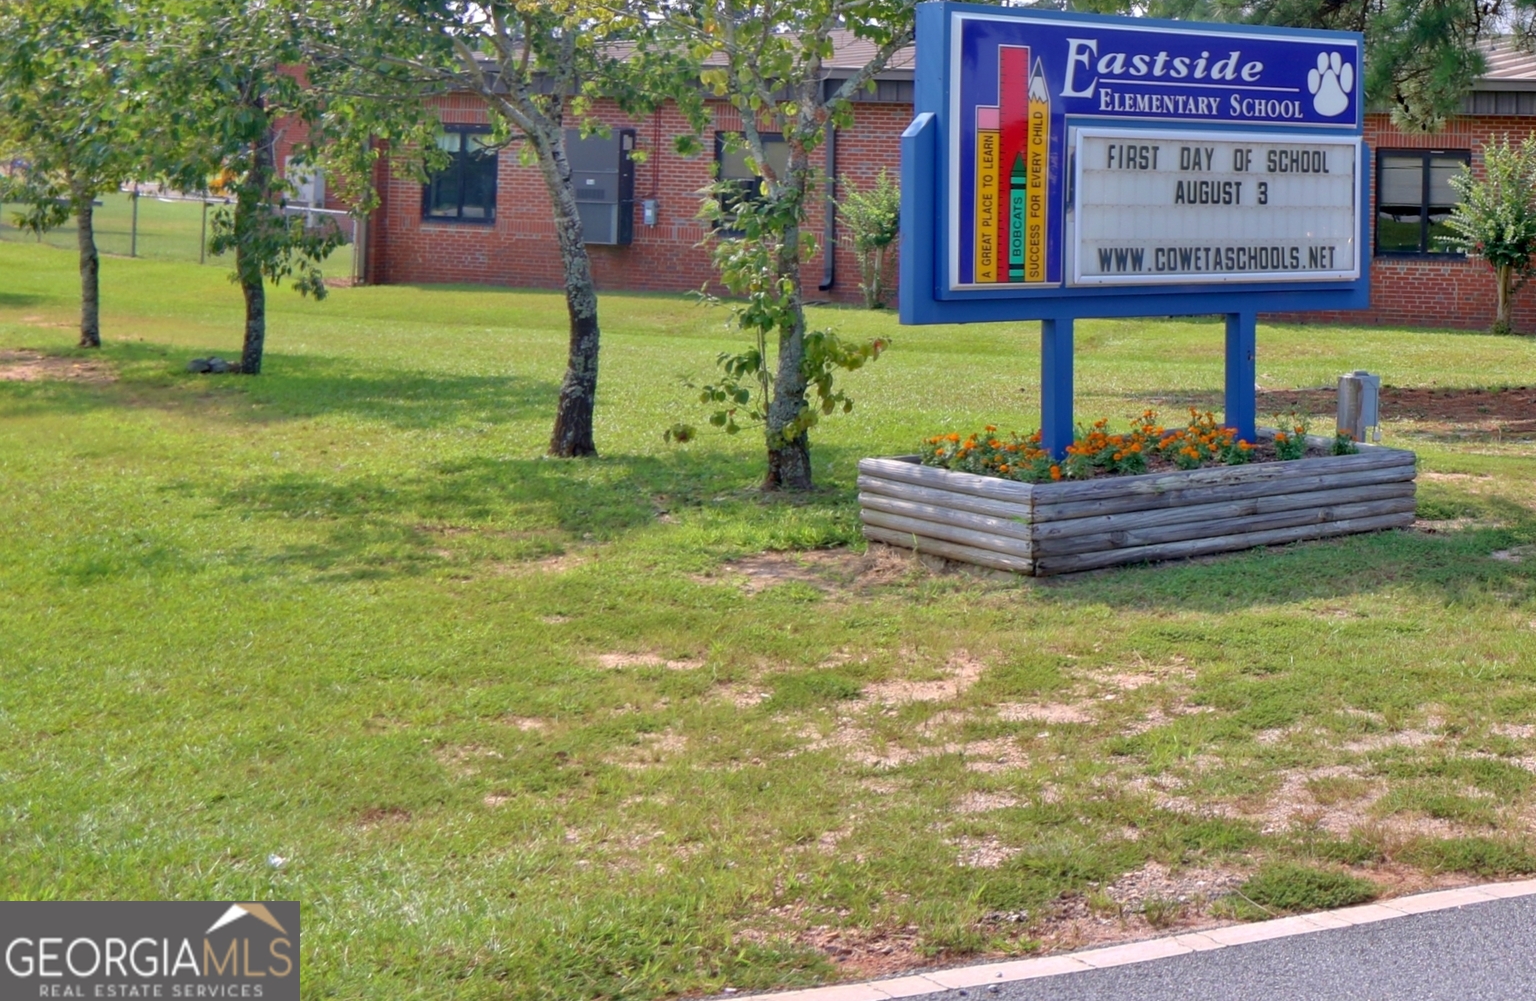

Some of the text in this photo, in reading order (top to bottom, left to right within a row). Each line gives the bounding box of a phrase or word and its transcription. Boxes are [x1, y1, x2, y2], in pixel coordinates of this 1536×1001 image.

[1059, 38, 1264, 99] Eastside
[1099, 88, 1304, 119] ELEMENTARY SCHOOL
[1107, 144, 1330, 174] FIRST DAY OF SCHOOL
[981, 135, 995, 279] A GREAT PLACE TO LEARN
[1029, 111, 1044, 278] SUCCESS FOR EVERY CHILD
[1174, 180, 1269, 205] AUGUST 3
[1012, 196, 1024, 257] BOBCATS
[1098, 246, 1336, 273] WWW.COWETASCHOOLS.NET
